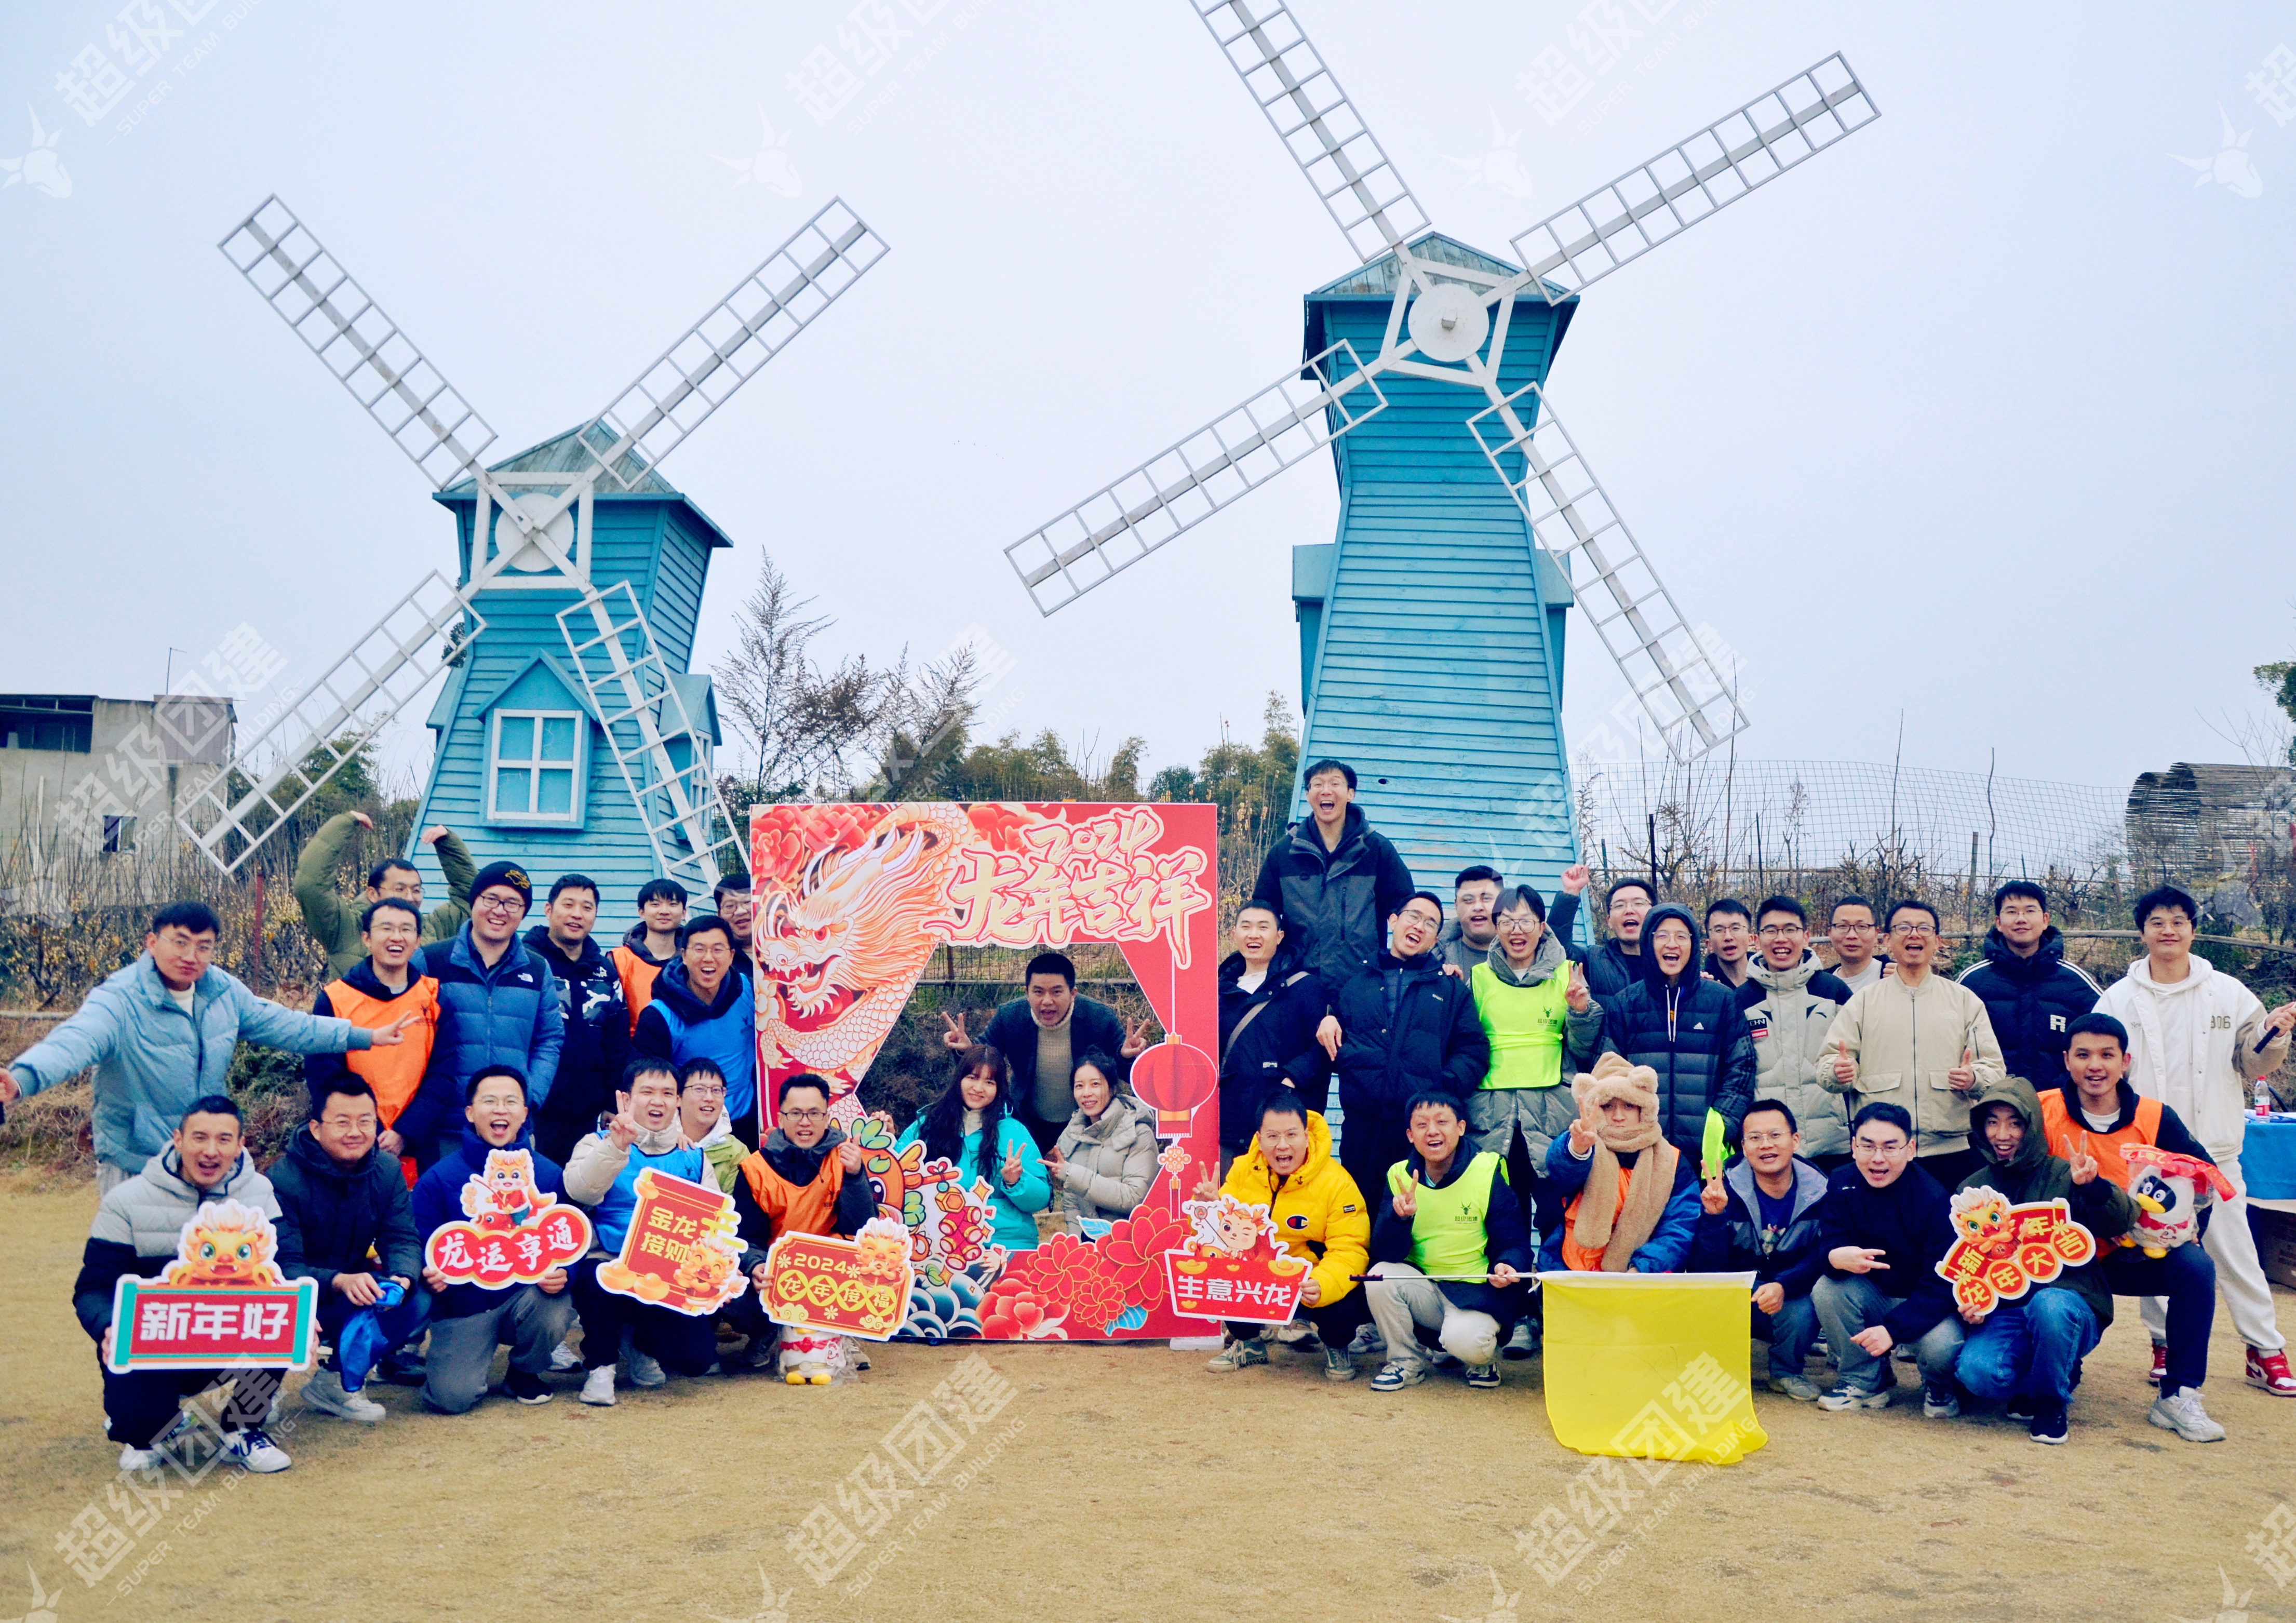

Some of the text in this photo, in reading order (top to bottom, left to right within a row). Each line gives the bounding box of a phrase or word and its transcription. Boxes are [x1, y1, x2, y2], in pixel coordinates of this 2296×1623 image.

[1024, 811, 1159, 865] 2024
[923, 852, 1208, 965] 龙年吉祥
[647, 1206, 697, 1239] 金龙
[438, 1216, 579, 1273] 龙运亨通
[794, 1253, 847, 1274] 2024
[784, 1277, 891, 1309] 龙年接福
[1177, 1275, 1292, 1308] 生意兴龙
[140, 1302, 289, 1340] 新年好
